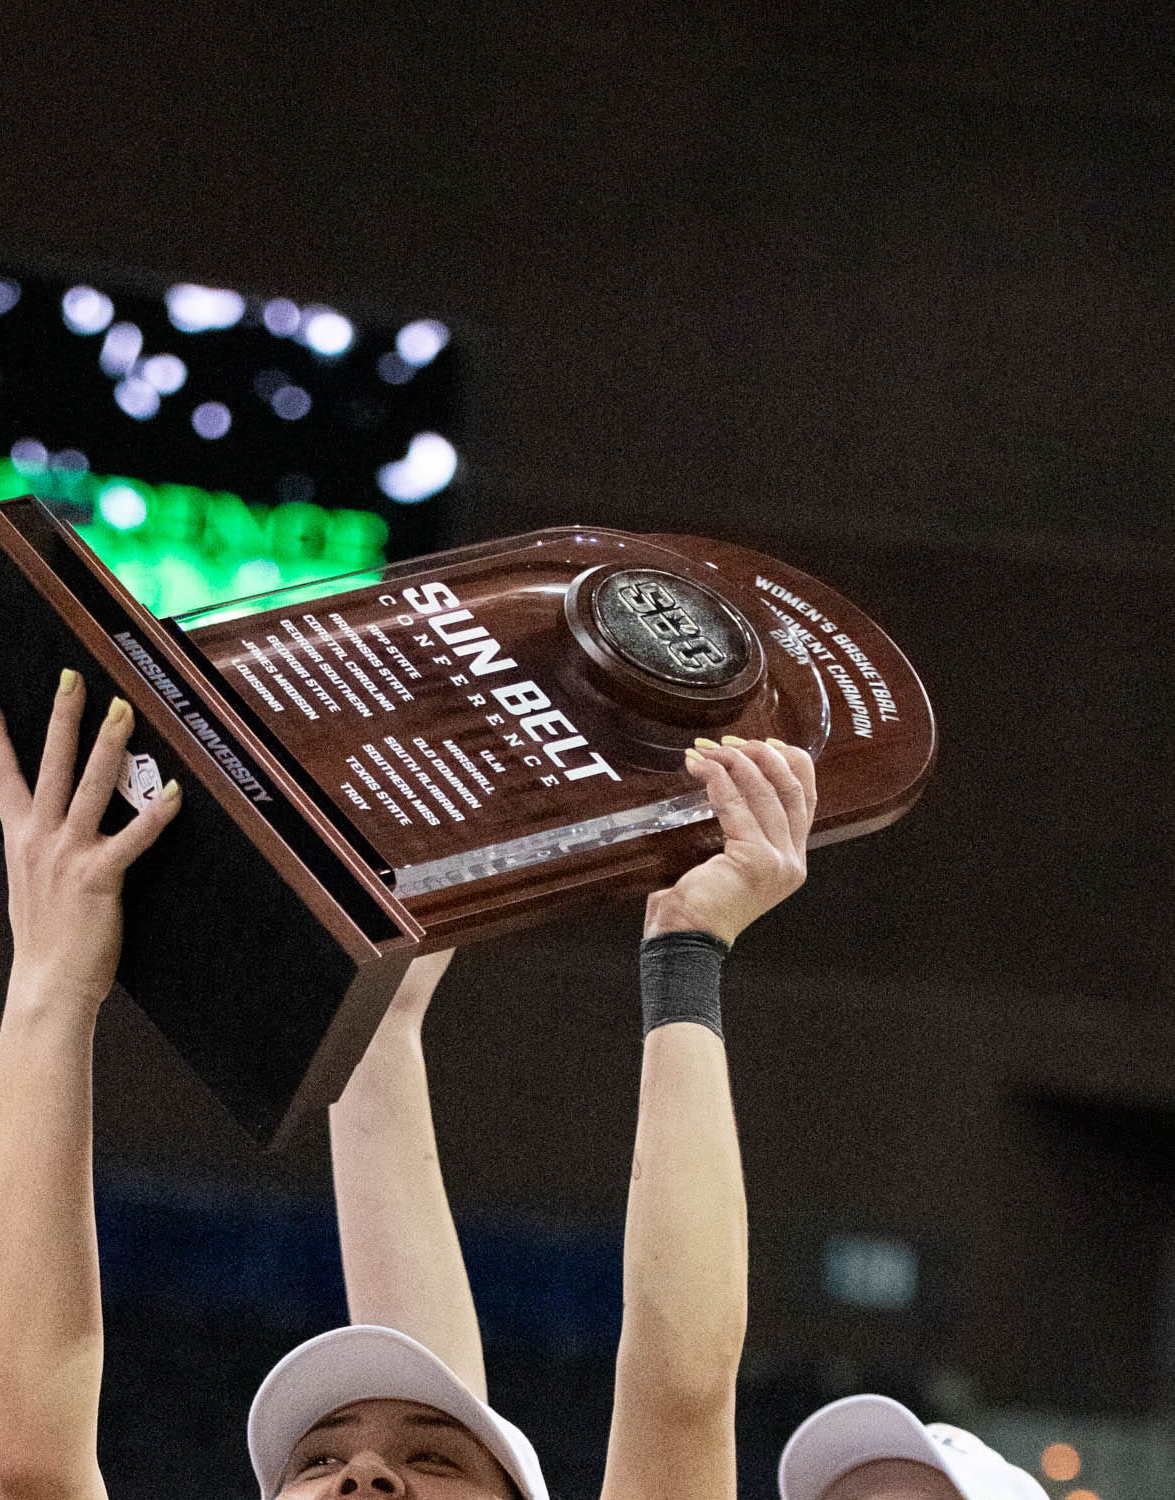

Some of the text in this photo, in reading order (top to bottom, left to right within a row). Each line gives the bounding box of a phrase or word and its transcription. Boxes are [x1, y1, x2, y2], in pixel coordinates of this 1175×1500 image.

[231, 657, 285, 713] LOUISIANA
[241, 639, 320, 721] JAMES MADISON
[266, 634, 342, 713] GEORGIA STATE
[279, 619, 374, 719] GEORGIA SOUTHERN
[303, 614, 396, 713] COASTAL CAROLINA
[329, 613, 415, 702] ARKANSAS STATE
[367, 623, 422, 680] APP STATE
[402, 582, 623, 783] SUN BELT
[755, 575, 900, 722] WOMEN'S BASKETBALL
[114, 631, 274, 802] MARSHALL UNIVERSITY
[379, 594, 559, 788] CONFERENCE
[827, 664, 873, 739] CHAMPION
[340, 782, 372, 811] TROY
[345, 755, 413, 827] TEXAS STATE
[362, 743, 441, 827] SOUTHERN MISS
[383, 735, 466, 823] SOUTH ALABAMA
[412, 737, 483, 809] OLD DOMINION
[442, 739, 496, 796] MARSHALL
[479, 749, 507, 774] ULM
